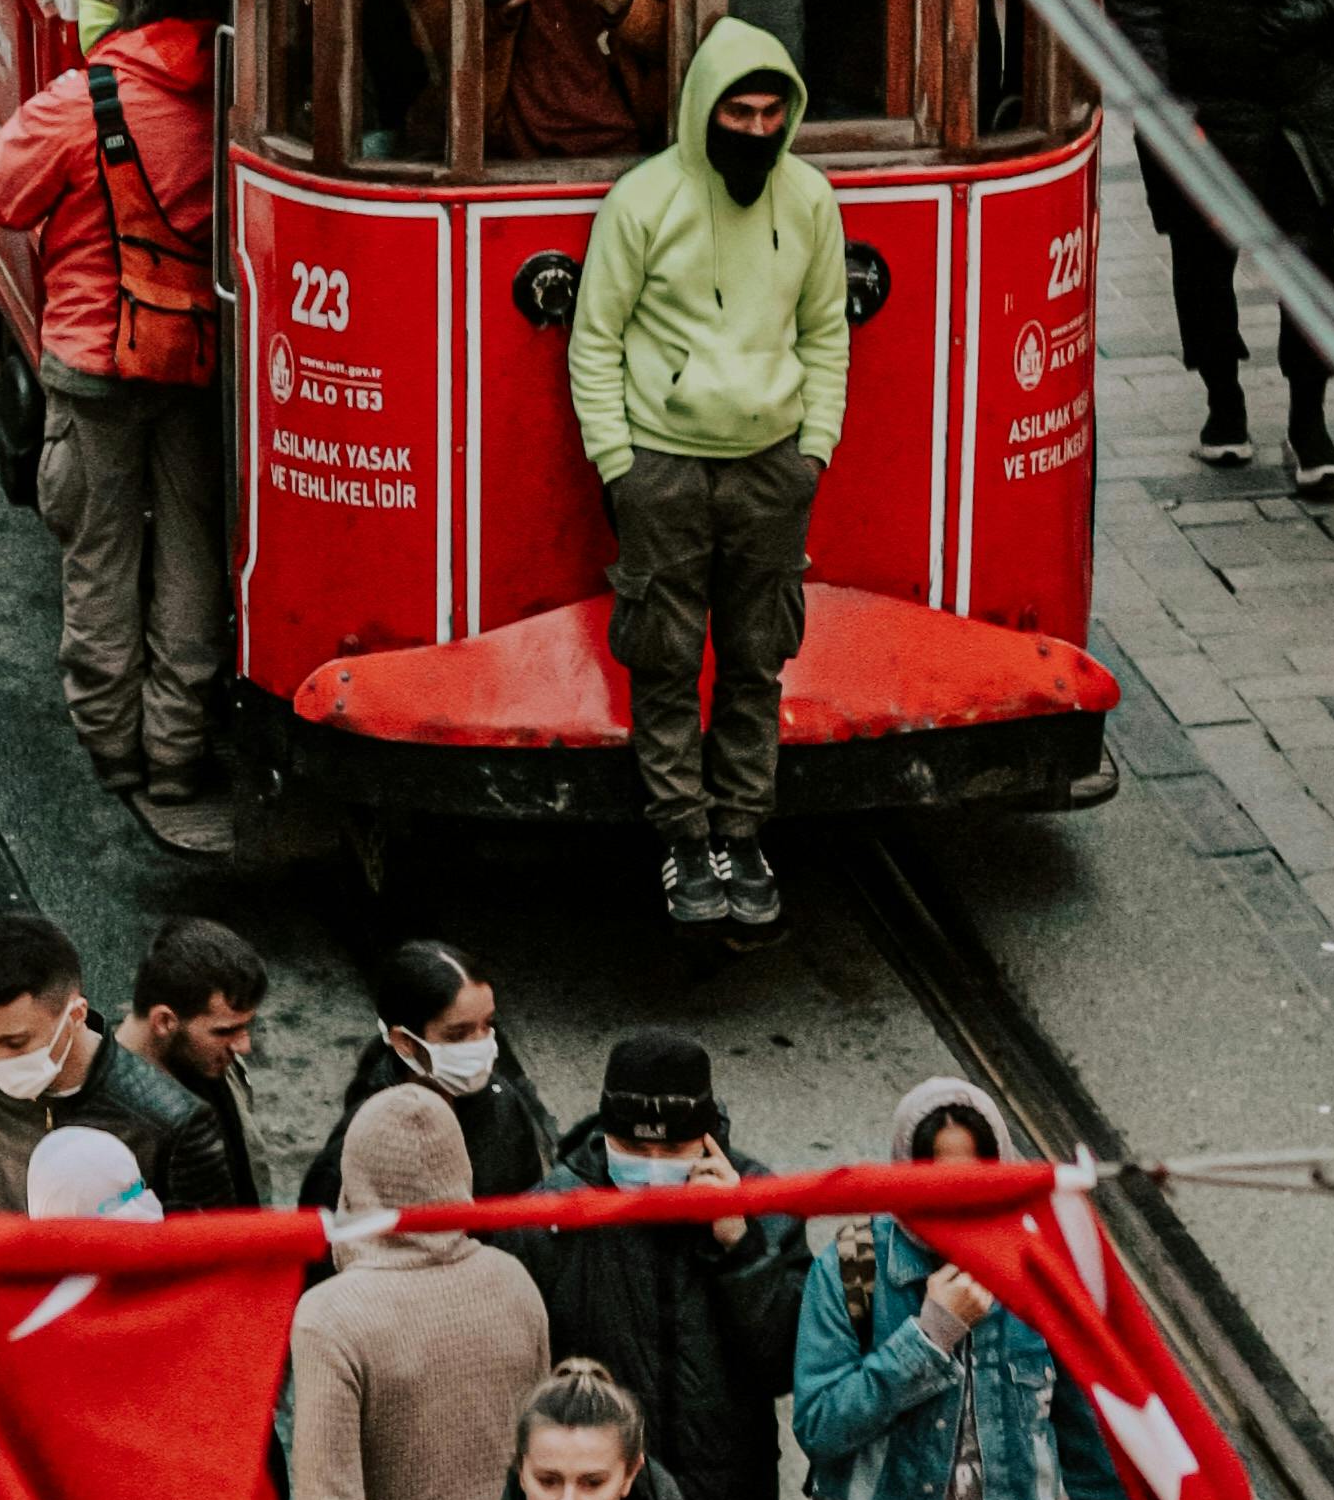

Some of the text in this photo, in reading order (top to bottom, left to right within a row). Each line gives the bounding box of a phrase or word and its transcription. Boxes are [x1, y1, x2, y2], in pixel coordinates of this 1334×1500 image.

[1047, 226, 1083, 300] 223
[291, 261, 350, 332] 223
[300, 379, 383, 412] ALO 153
[1008, 403, 1071, 444] ASILMAK
[272, 429, 411, 472] ASILMAK YASAK
[1004, 455, 1025, 481] VE
[270, 462, 286, 491] VE
